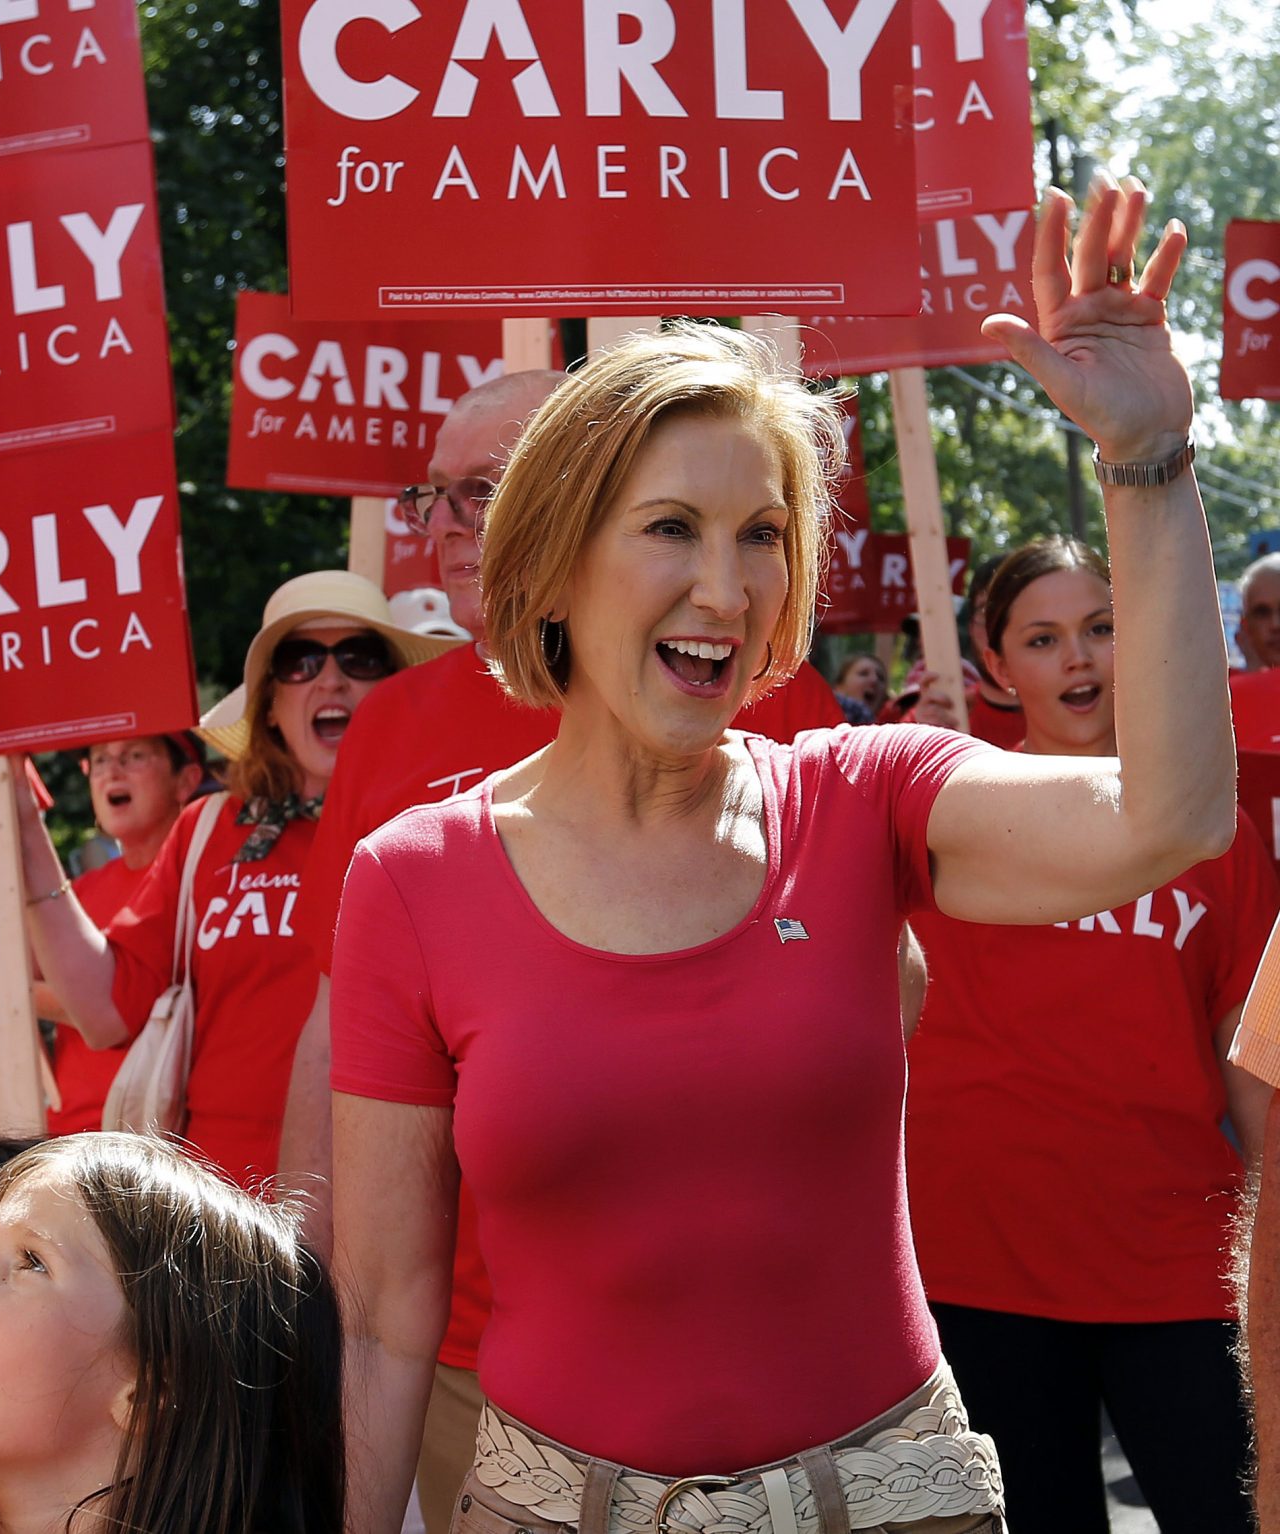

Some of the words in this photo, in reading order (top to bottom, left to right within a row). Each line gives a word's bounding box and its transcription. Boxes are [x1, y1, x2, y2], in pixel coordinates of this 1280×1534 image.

[298, 0, 898, 121] CARLY
[327, 146, 404, 206] for
[432, 144, 872, 201] AMERICA
[248, 408, 286, 438] for
[294, 411, 426, 449] AMERI
[214, 862, 301, 895] Team
